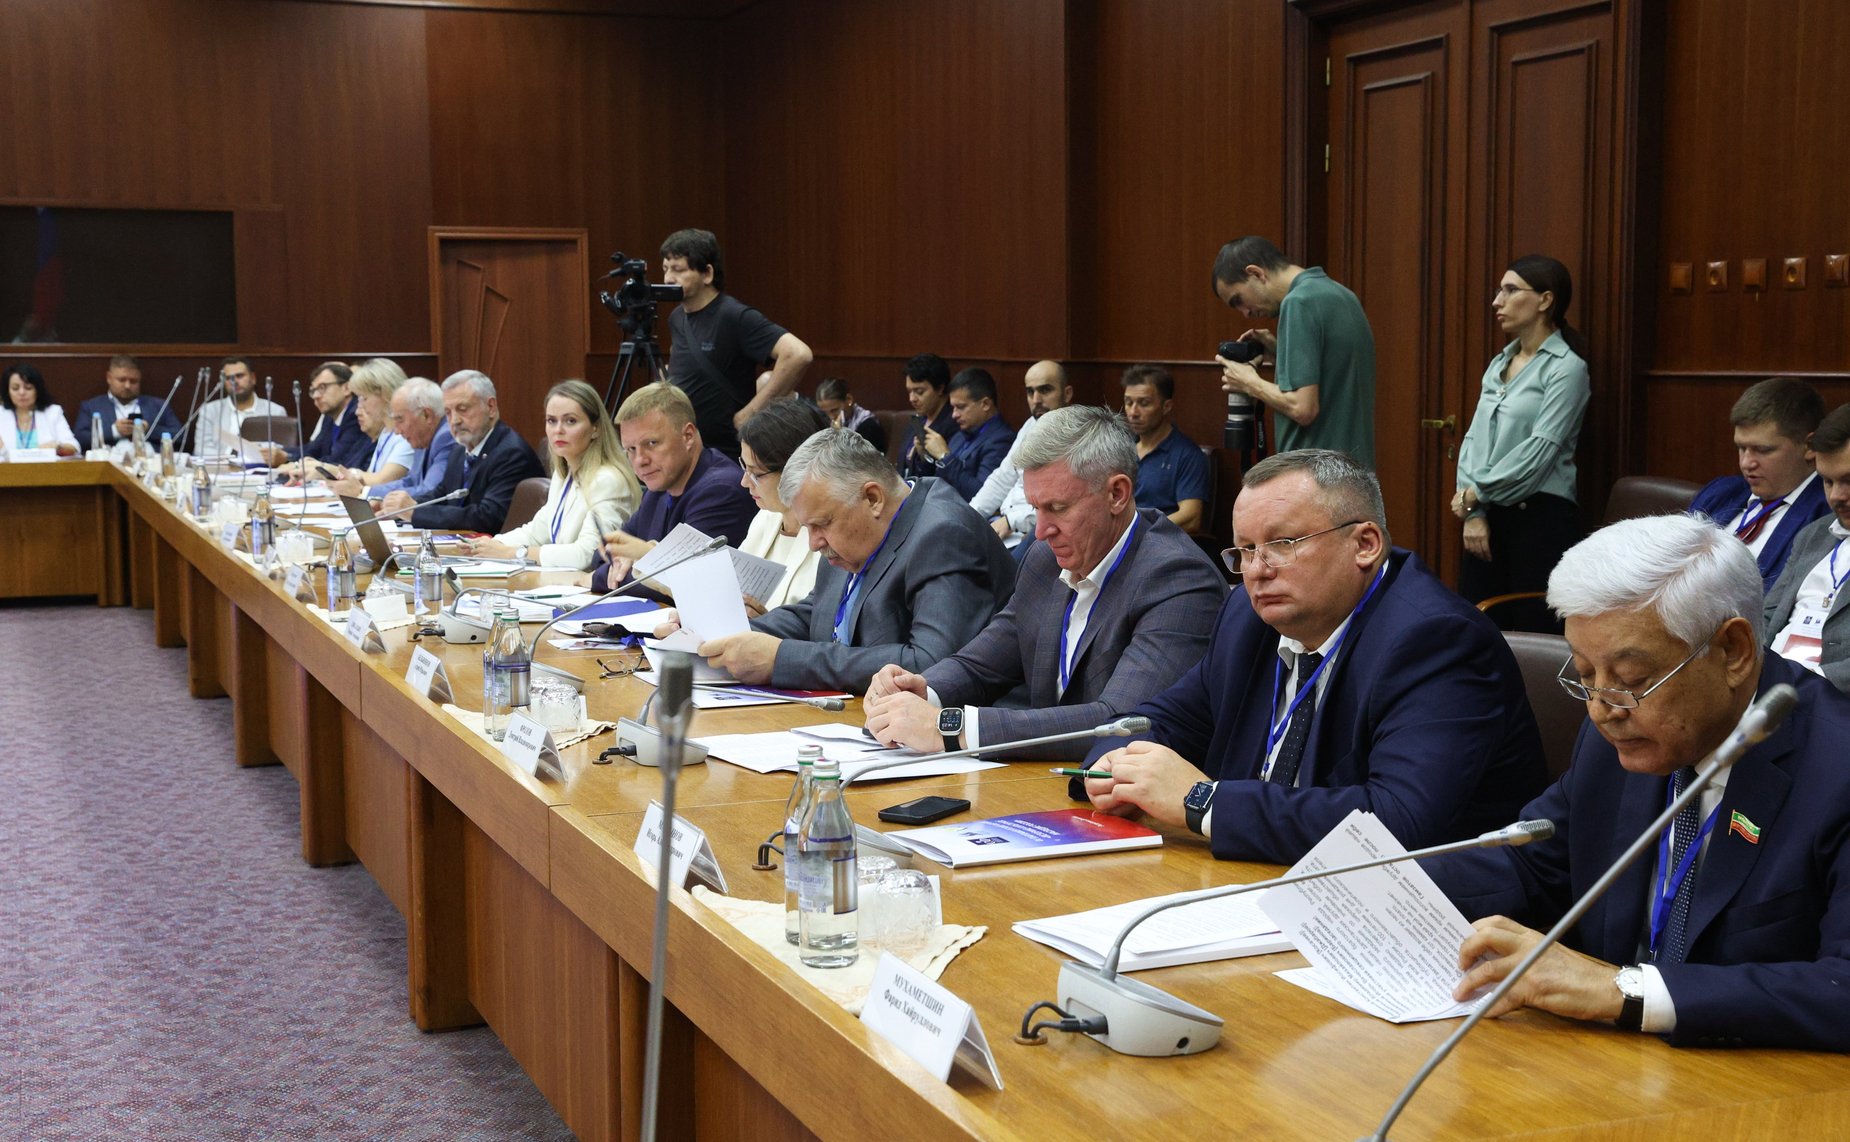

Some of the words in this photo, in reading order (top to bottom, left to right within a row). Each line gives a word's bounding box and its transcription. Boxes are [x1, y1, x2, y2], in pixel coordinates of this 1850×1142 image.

[883, 988, 901, 1010] Фарид
[900, 1004, 942, 1038] Хайруллович
[893, 973, 945, 1016] МУХАМЕТШИН
